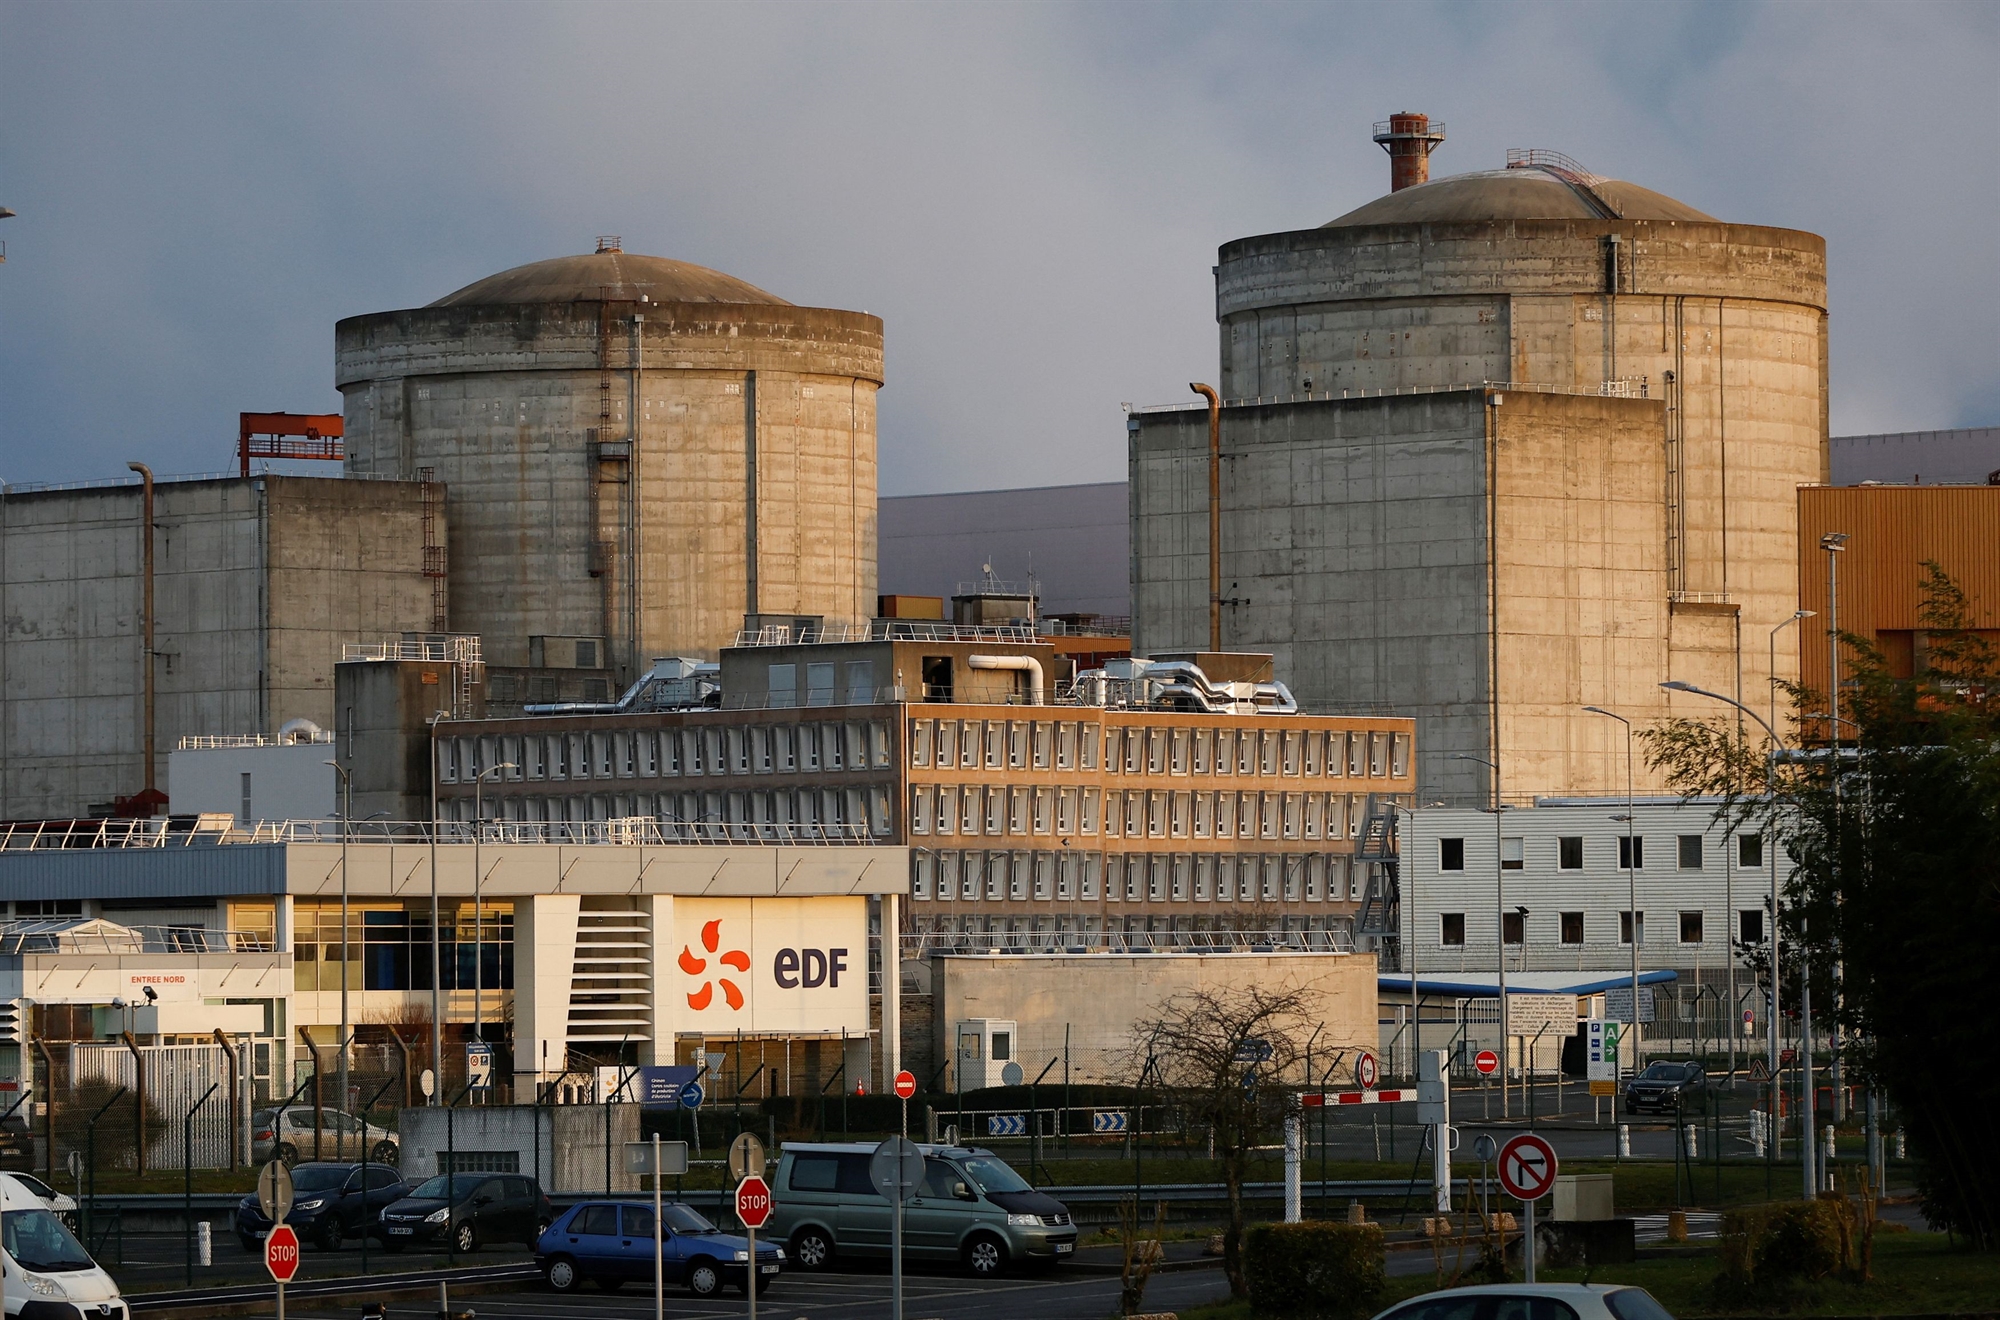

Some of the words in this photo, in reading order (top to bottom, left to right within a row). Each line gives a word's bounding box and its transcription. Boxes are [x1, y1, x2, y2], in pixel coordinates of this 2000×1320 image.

[131, 975, 162, 984] ENTREE
[163, 975, 186, 984] NORD
[1605, 1027, 1617, 1040] A
[741, 1194, 767, 1210] STOP
[270, 1245, 296, 1262] STOP
